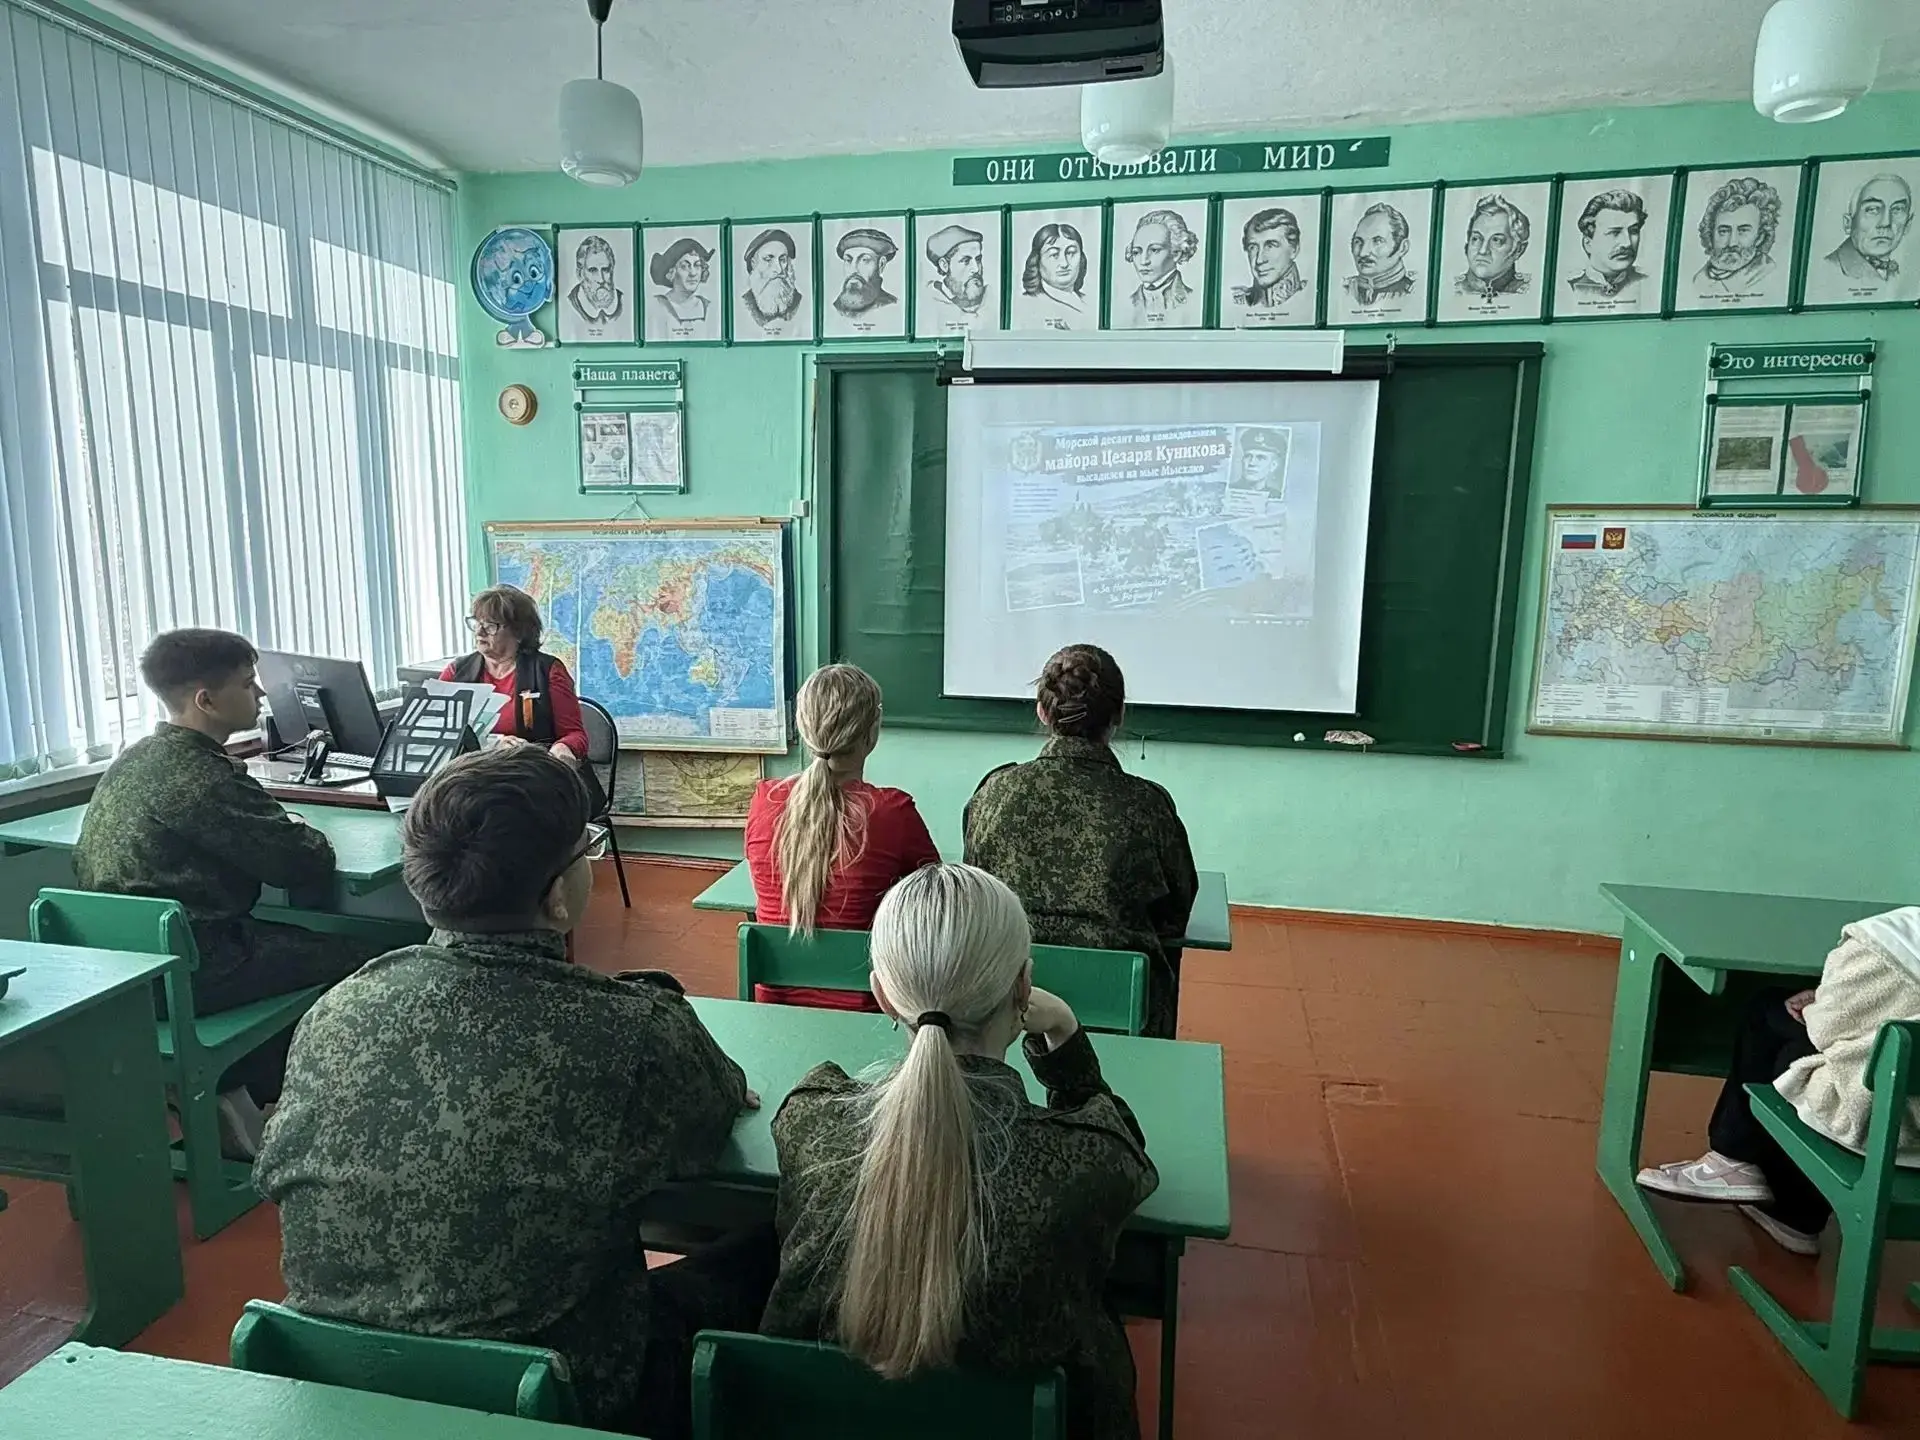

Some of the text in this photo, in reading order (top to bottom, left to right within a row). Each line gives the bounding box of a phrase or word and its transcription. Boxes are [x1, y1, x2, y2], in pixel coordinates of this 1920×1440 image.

[1719, 352, 1865, 371] Это интересно
[579, 367, 677, 381] Наша планета
[1055, 436, 1098, 453] Морской
[1045, 443, 1227, 471] майора Цезаря Куникова
